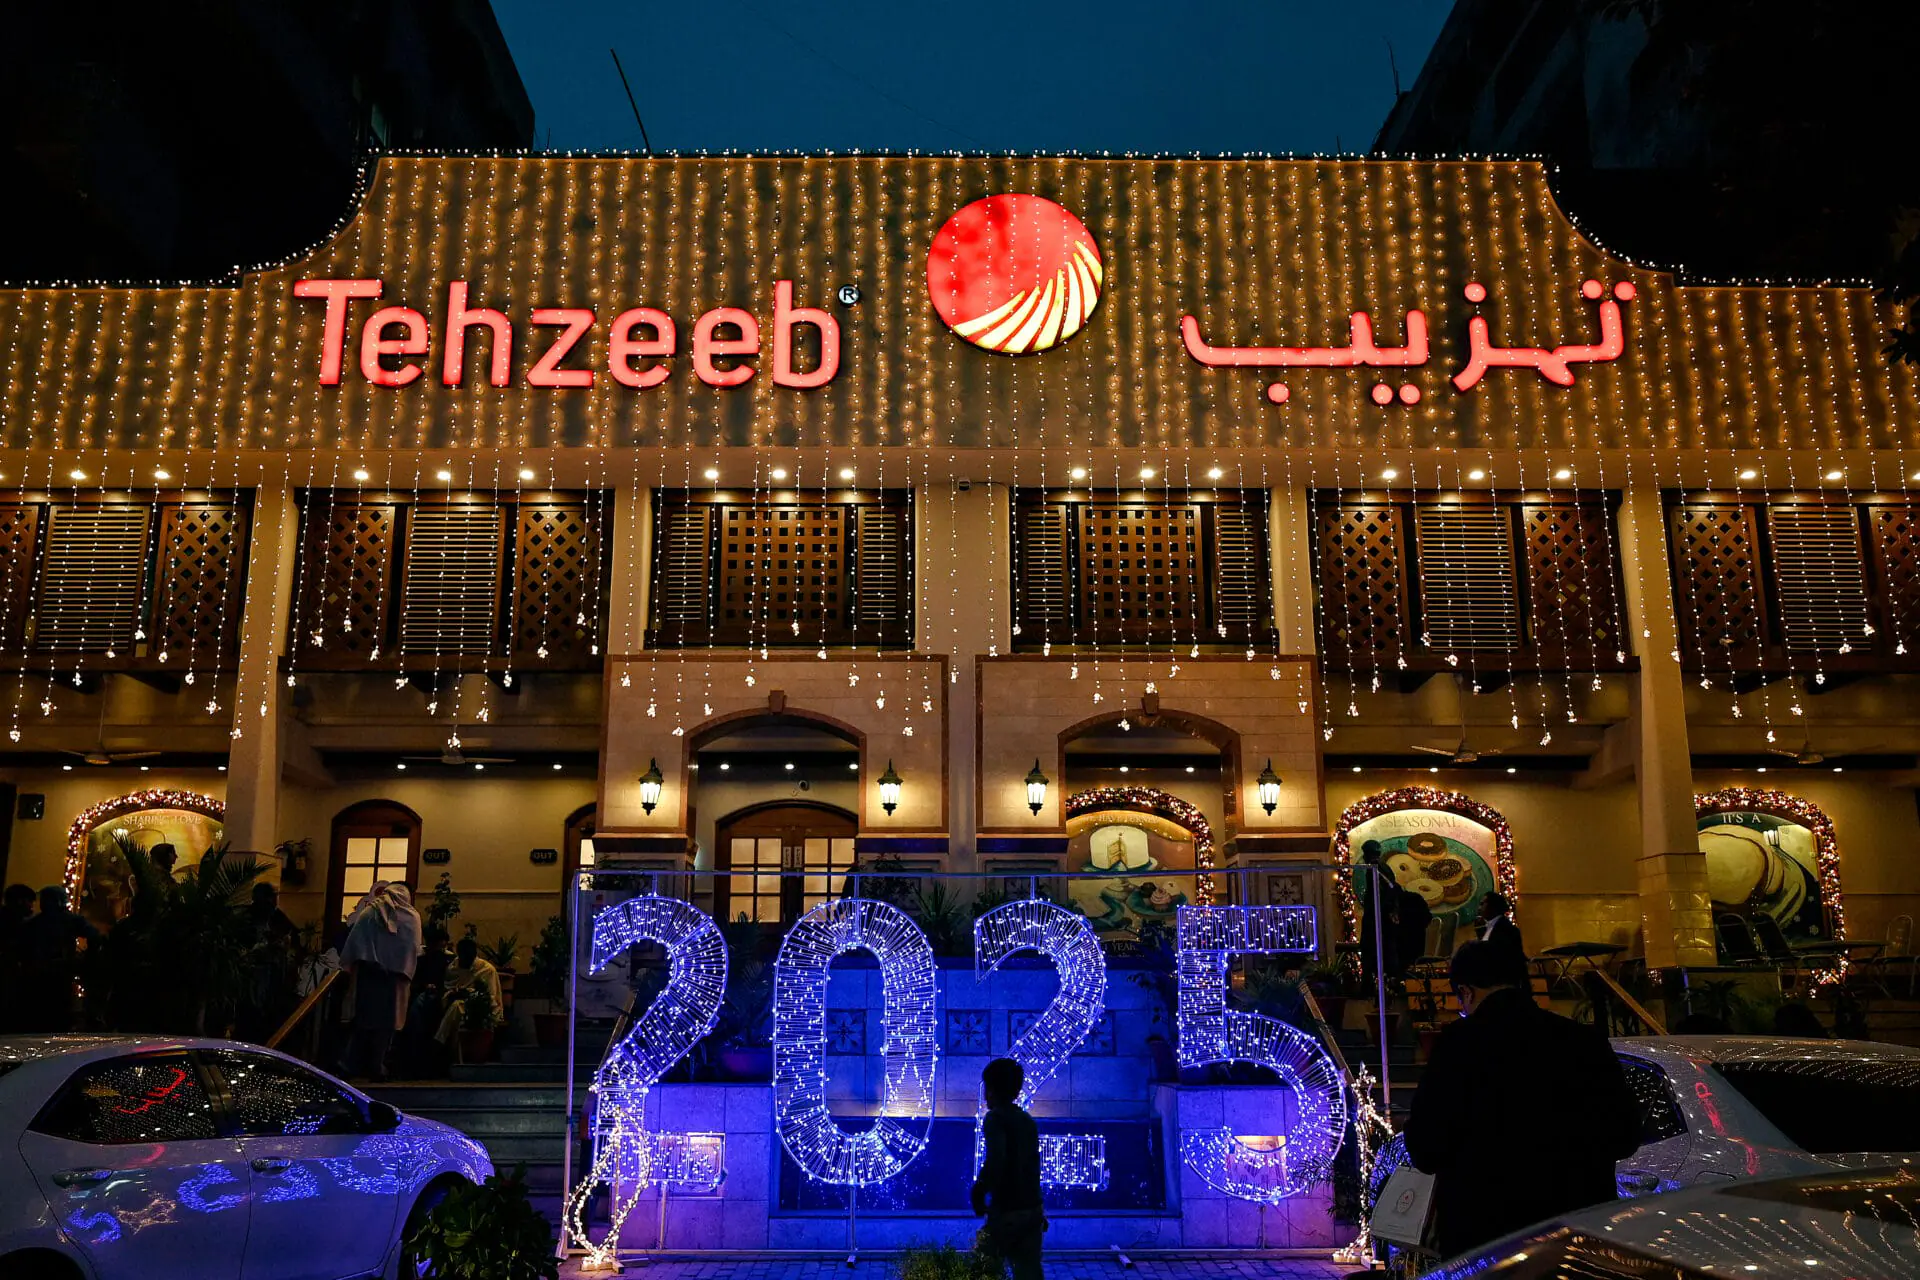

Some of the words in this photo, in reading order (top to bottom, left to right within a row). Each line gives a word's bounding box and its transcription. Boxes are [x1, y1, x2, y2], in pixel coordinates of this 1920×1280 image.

[294, 279, 841, 387] Tehzeeb
[124, 815, 170, 825] SHARING
[174, 815, 202, 825] LOVE
[1385, 815, 1459, 828] SEASONAL
[1722, 812, 1744, 824] IT'S
[1751, 813, 1761, 823] A
[426, 851, 446, 860] OUT
[533, 851, 553, 860] OUT
[590, 895, 1346, 1203] 2025
